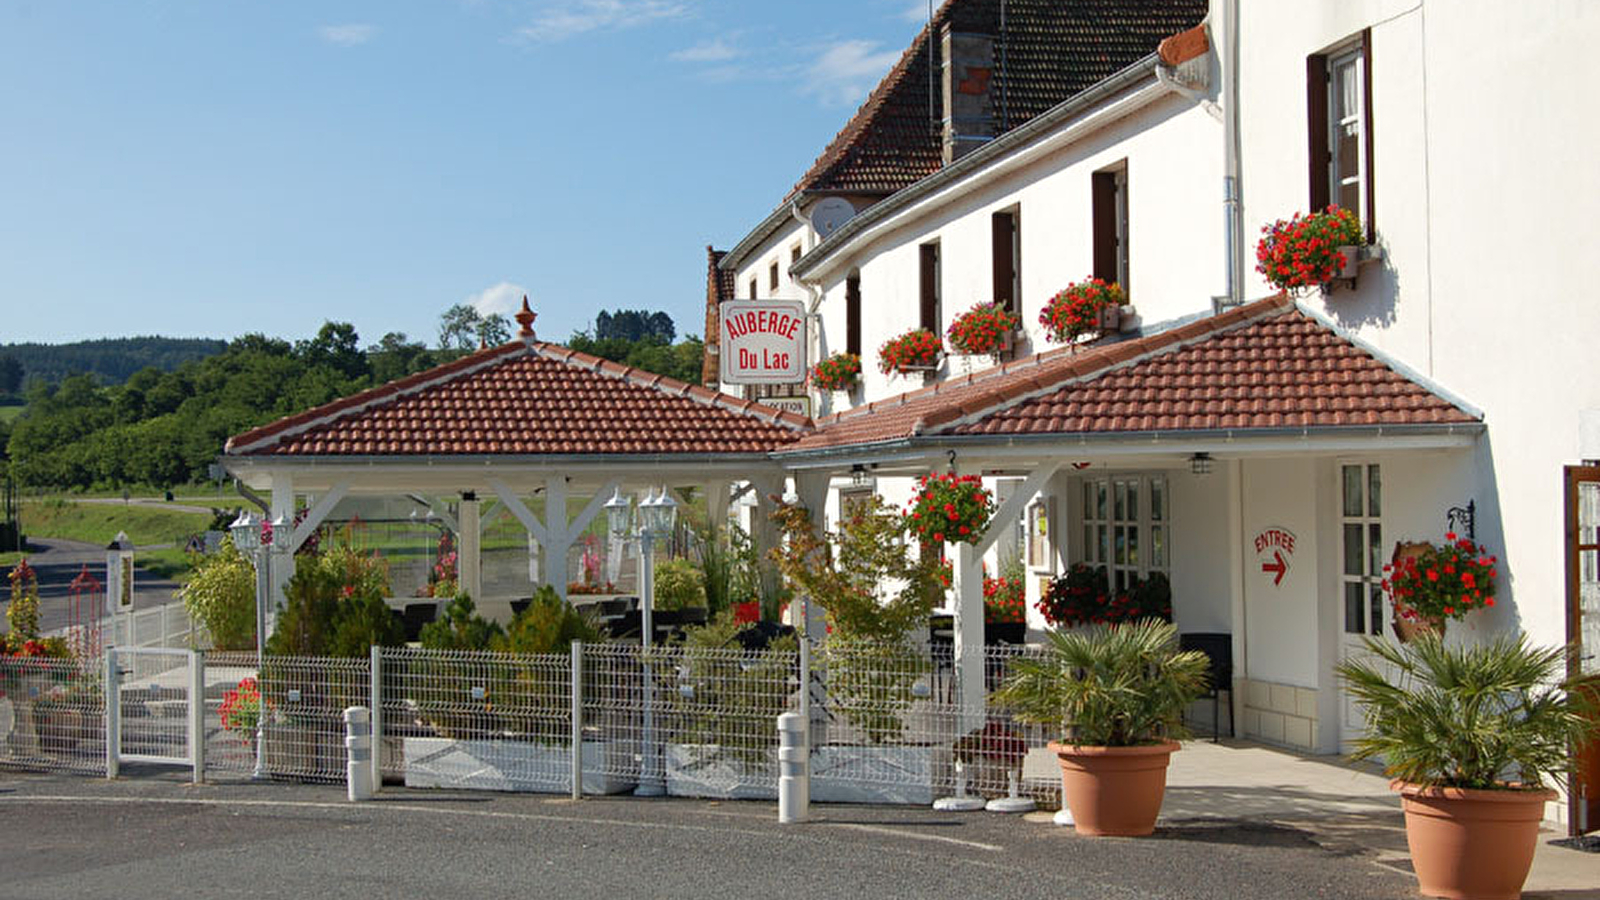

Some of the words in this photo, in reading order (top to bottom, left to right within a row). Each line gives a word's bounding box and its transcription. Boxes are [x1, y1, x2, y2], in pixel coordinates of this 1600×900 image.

[725, 310, 802, 340] AUBERGE
[739, 348, 758, 370] Du
[763, 348, 789, 370] Lac
[764, 402, 803, 411] OCATION
